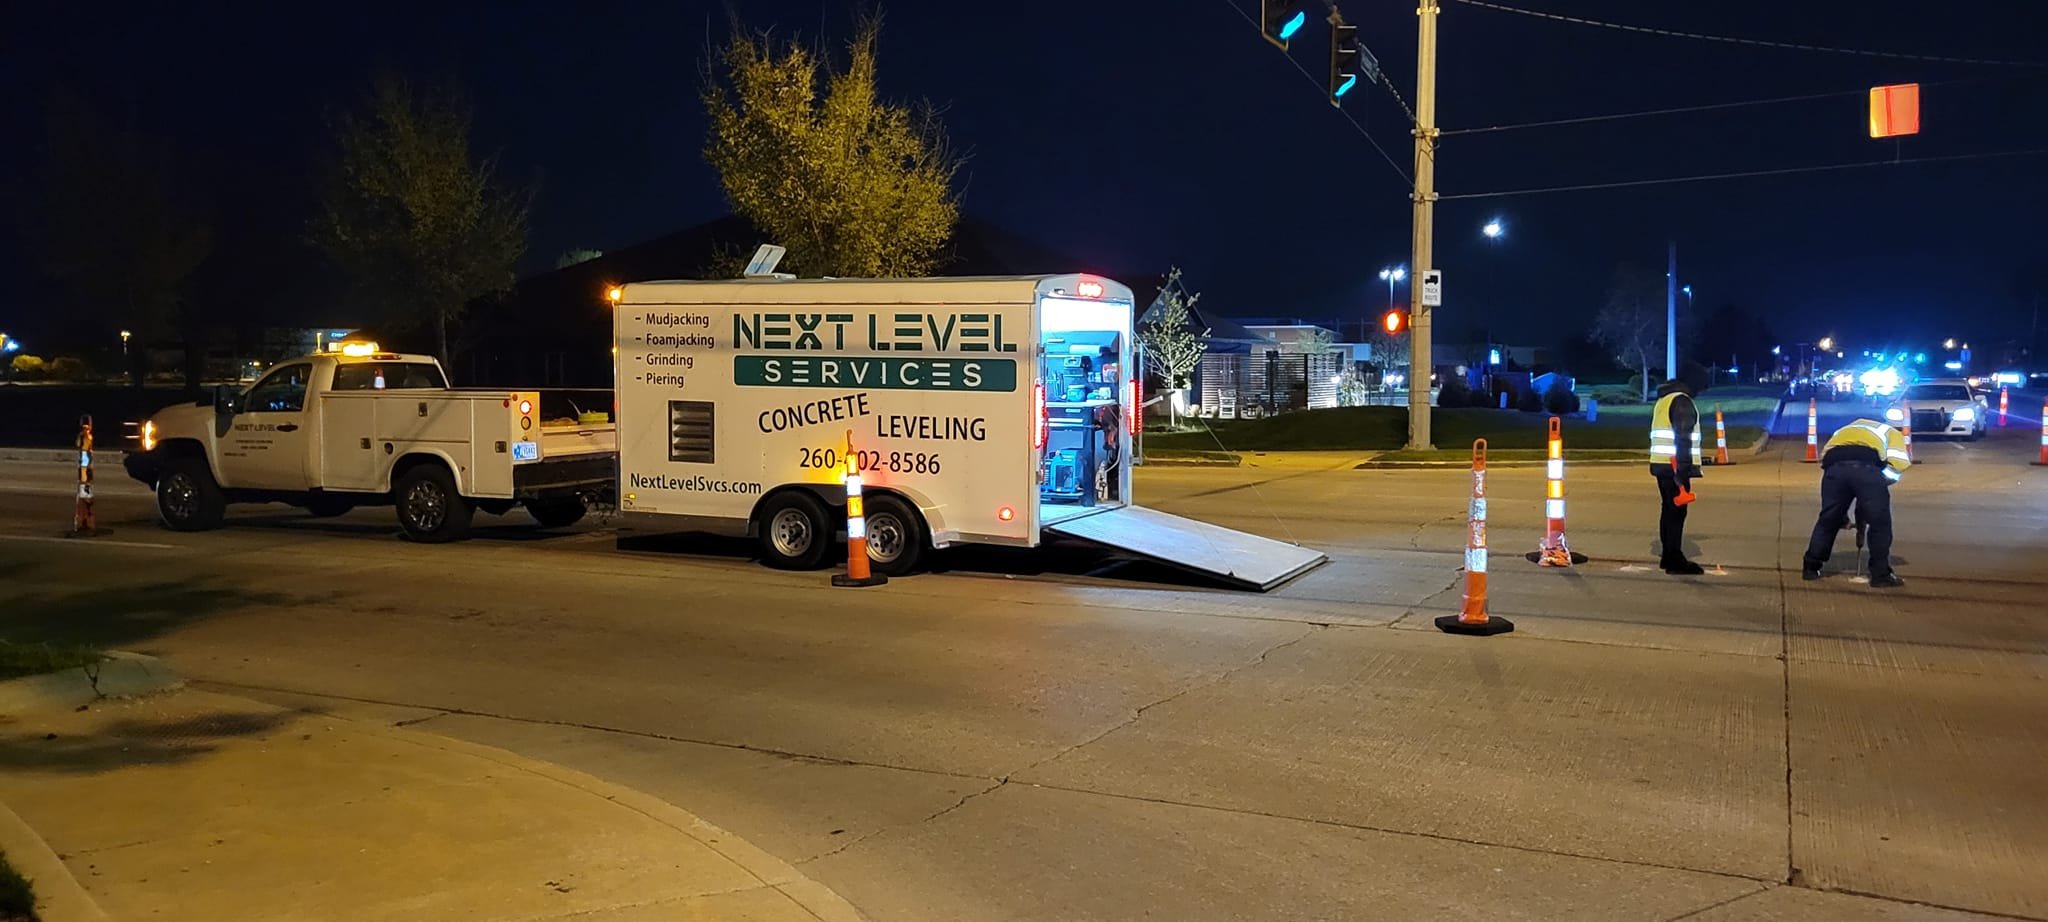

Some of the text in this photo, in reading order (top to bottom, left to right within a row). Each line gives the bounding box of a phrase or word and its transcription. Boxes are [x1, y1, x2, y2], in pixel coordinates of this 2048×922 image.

[645, 312, 710, 328] Mudjacking
[645, 332, 715, 349] Foamjacking
[733, 313, 1018, 352] NEXT LEVEL
[646, 353, 694, 369] Grinding
[646, 372, 684, 388] Piering
[763, 360, 982, 387] SERVICES
[758, 392, 870, 433] CONCRETE
[254, 424, 276, 432] LEVEL
[877, 415, 986, 441] LEVELING
[799, 447, 941, 475] 260-02-8586
[630, 472, 762, 494] NextLevelSvcs.com
